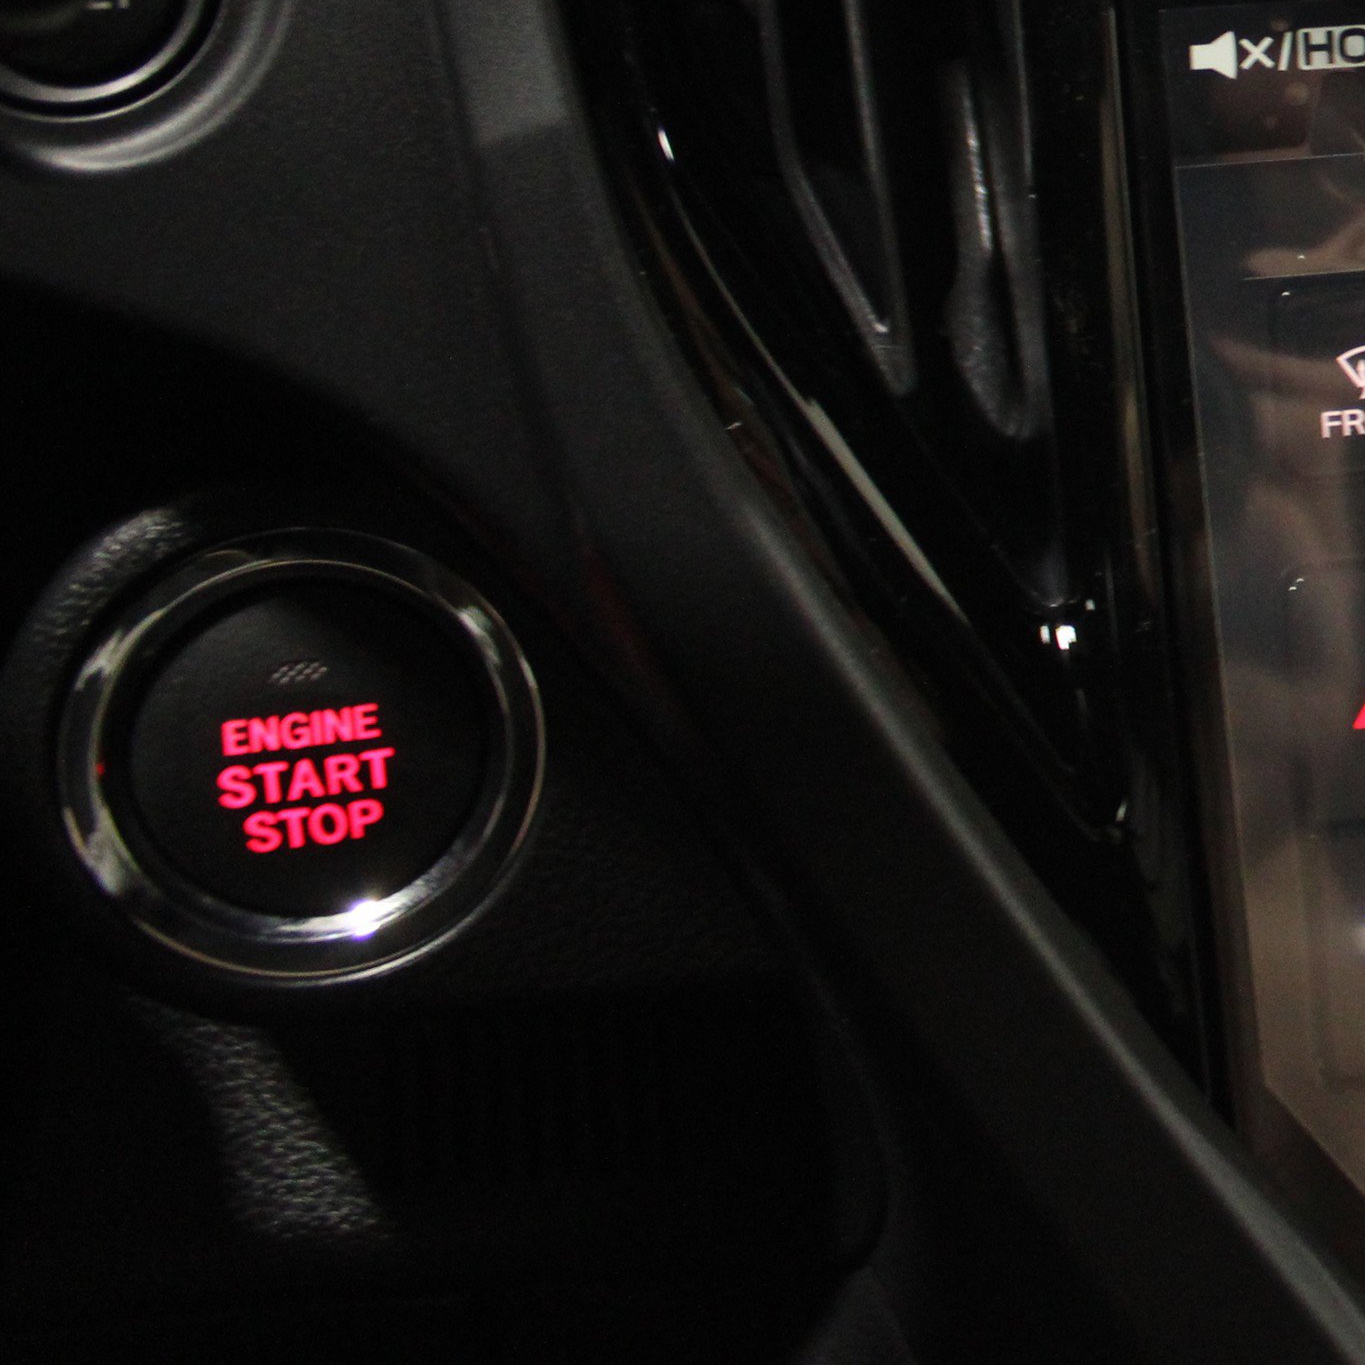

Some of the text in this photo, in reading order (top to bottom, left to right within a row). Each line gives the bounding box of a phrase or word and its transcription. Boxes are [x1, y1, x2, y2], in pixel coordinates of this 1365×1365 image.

[220, 702, 383, 757] ENGINE
[216, 747, 396, 809] START
[242, 799, 385, 854] STOP
